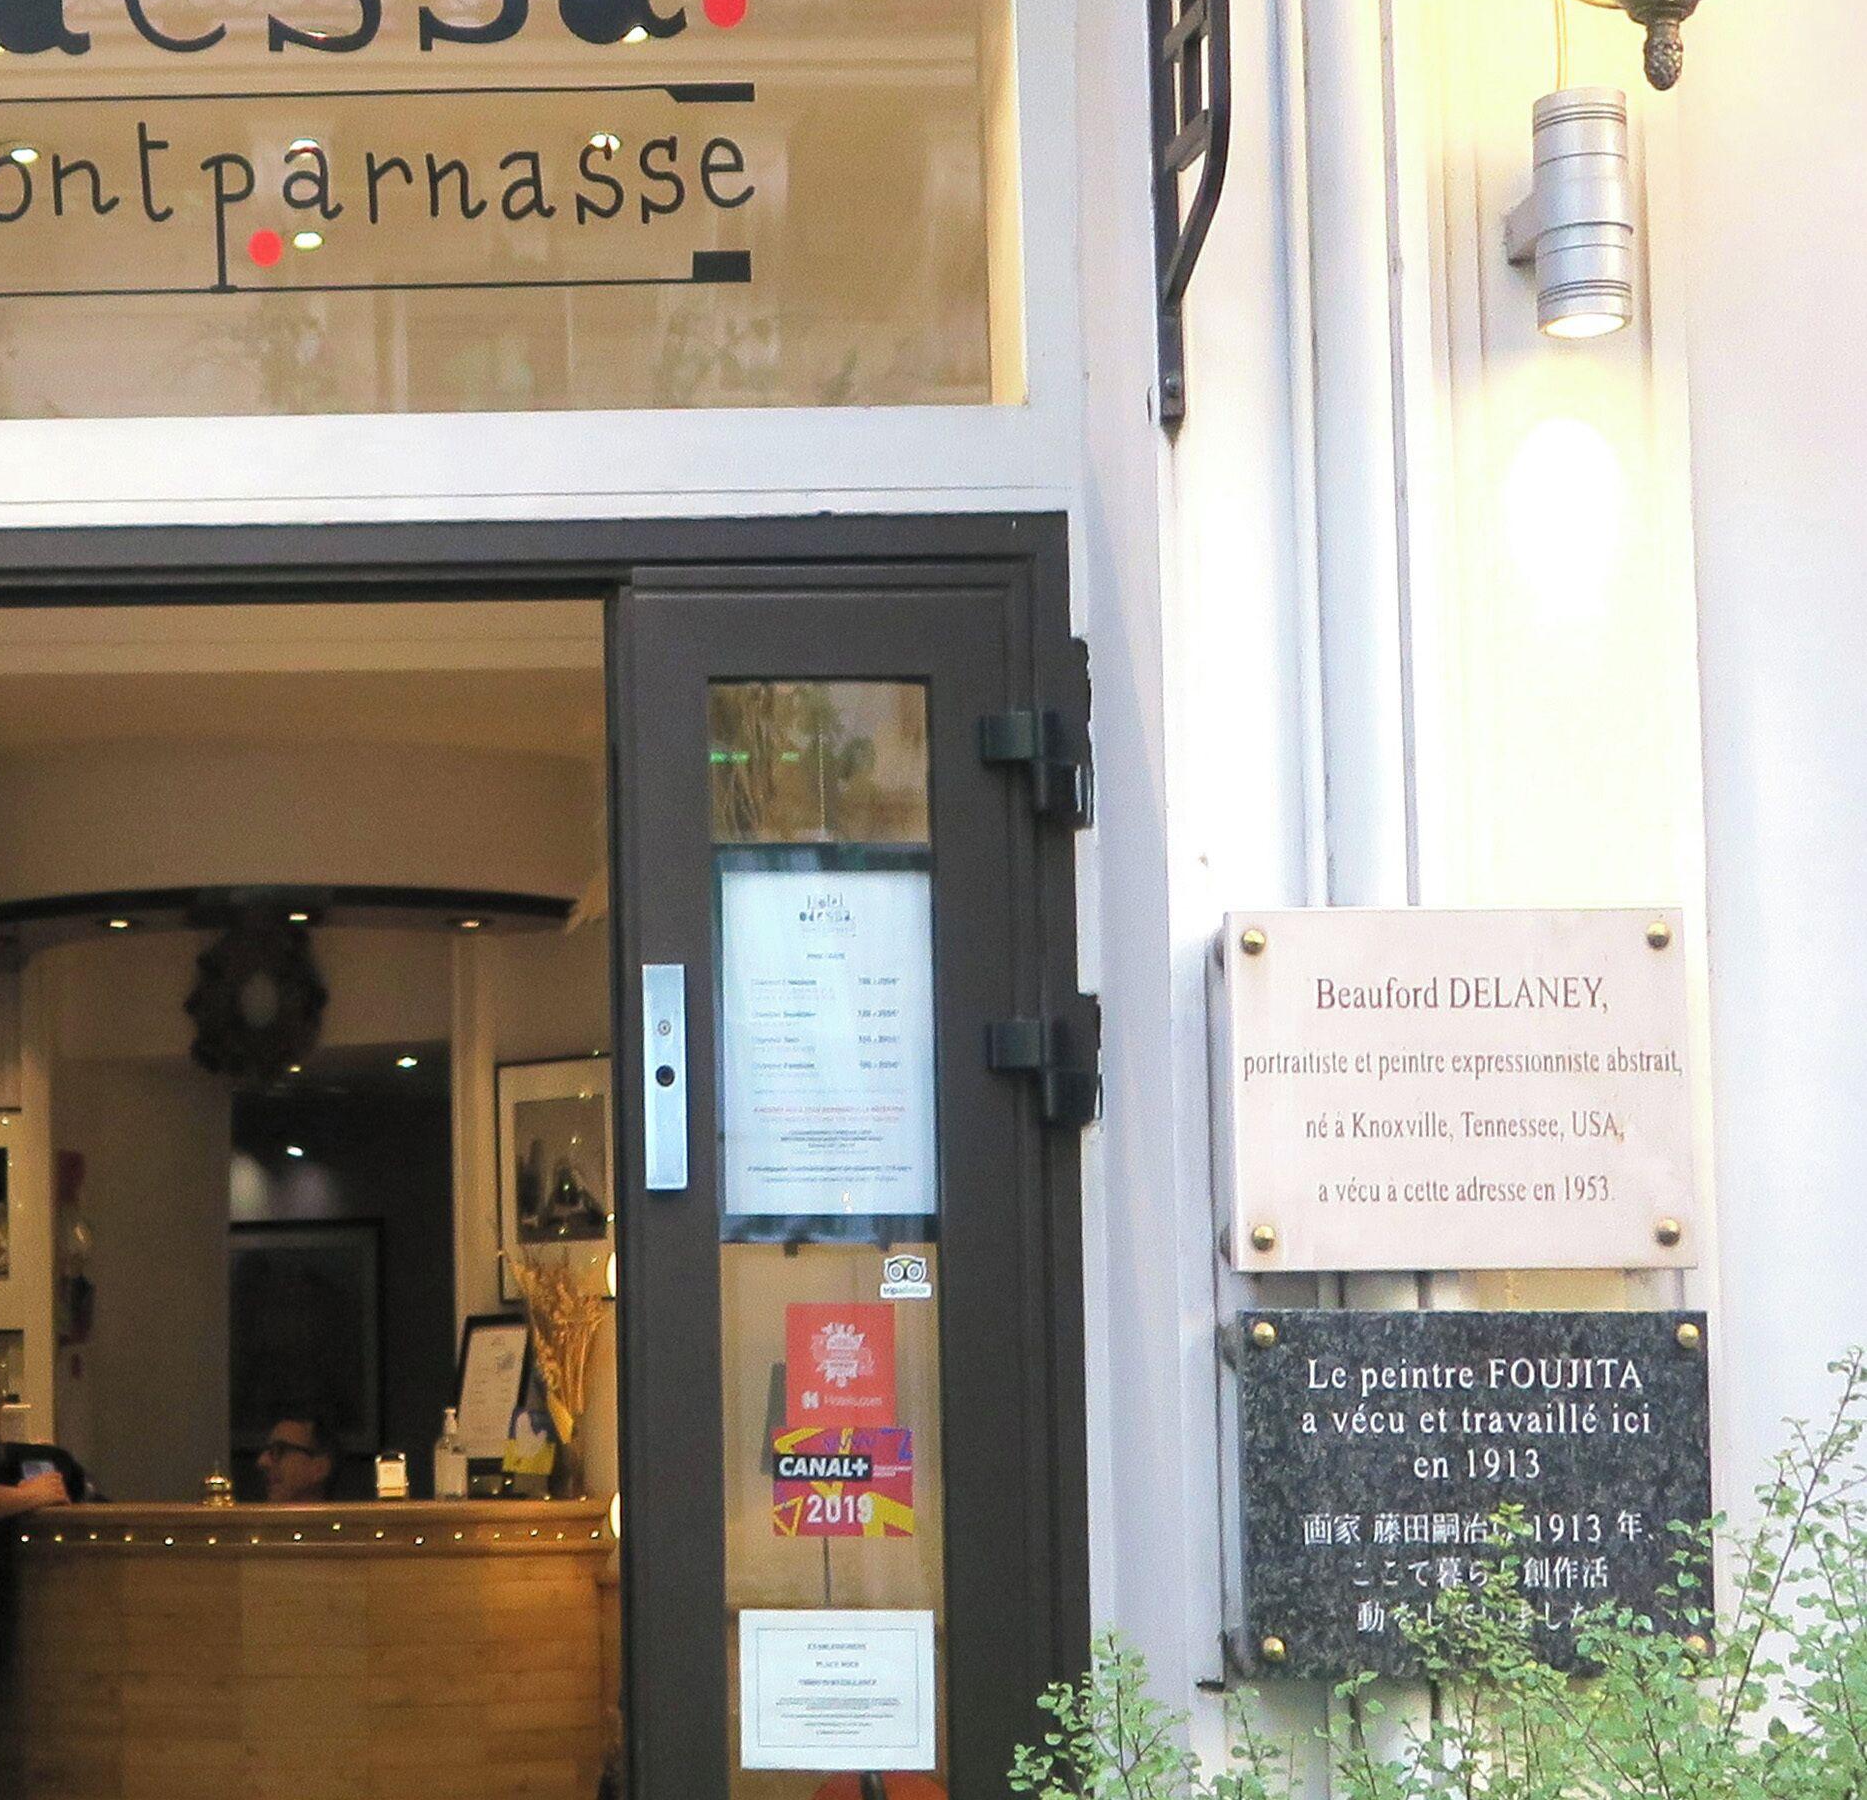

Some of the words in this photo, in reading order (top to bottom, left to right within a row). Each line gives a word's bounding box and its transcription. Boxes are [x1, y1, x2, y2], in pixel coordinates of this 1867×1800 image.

[1316, 975, 1439, 1010] Beauford
[1449, 975, 1609, 1015] DELANEY,
[1243, 1047, 1348, 1082] portraitiste
[1354, 1052, 1373, 1074] et
[1378, 1048, 1445, 1082] peintre
[1451, 1047, 1600, 1082] expressionniste
[1606, 1045, 1684, 1078] abstrait,
[1306, 1112, 1328, 1139] né
[1334, 1114, 1346, 1138] à
[1352, 1111, 1455, 1142] Knoxville,
[1460, 1111, 1566, 1142] Tennessee,
[1572, 1110, 1627, 1143] USA,
[1318, 1183, 1329, 1203] a
[1335, 1175, 1382, 1203] vécu
[1387, 1177, 1398, 1203] à
[1403, 1180, 1450, 1203] cette
[1455, 1174, 1527, 1203] adresse
[1533, 1183, 1556, 1203] en
[1308, 1358, 1347, 1389] Le
[1360, 1358, 1474, 1398] peintre
[1488, 1357, 1643, 1389] FOUJITA
[1302, 1411, 1318, 1434] a
[1332, 1403, 1405, 1434] vécu
[1419, 1407, 1448, 1434] et
[1462, 1401, 1597, 1434] travaillé
[1612, 1401, 1651, 1434] ici
[778, 1456, 869, 1477] CANAL+
[1413, 1456, 1449, 1479] en
[1466, 1447, 1541, 1479] 1913
[1533, 1512, 1603, 1544] 1913
